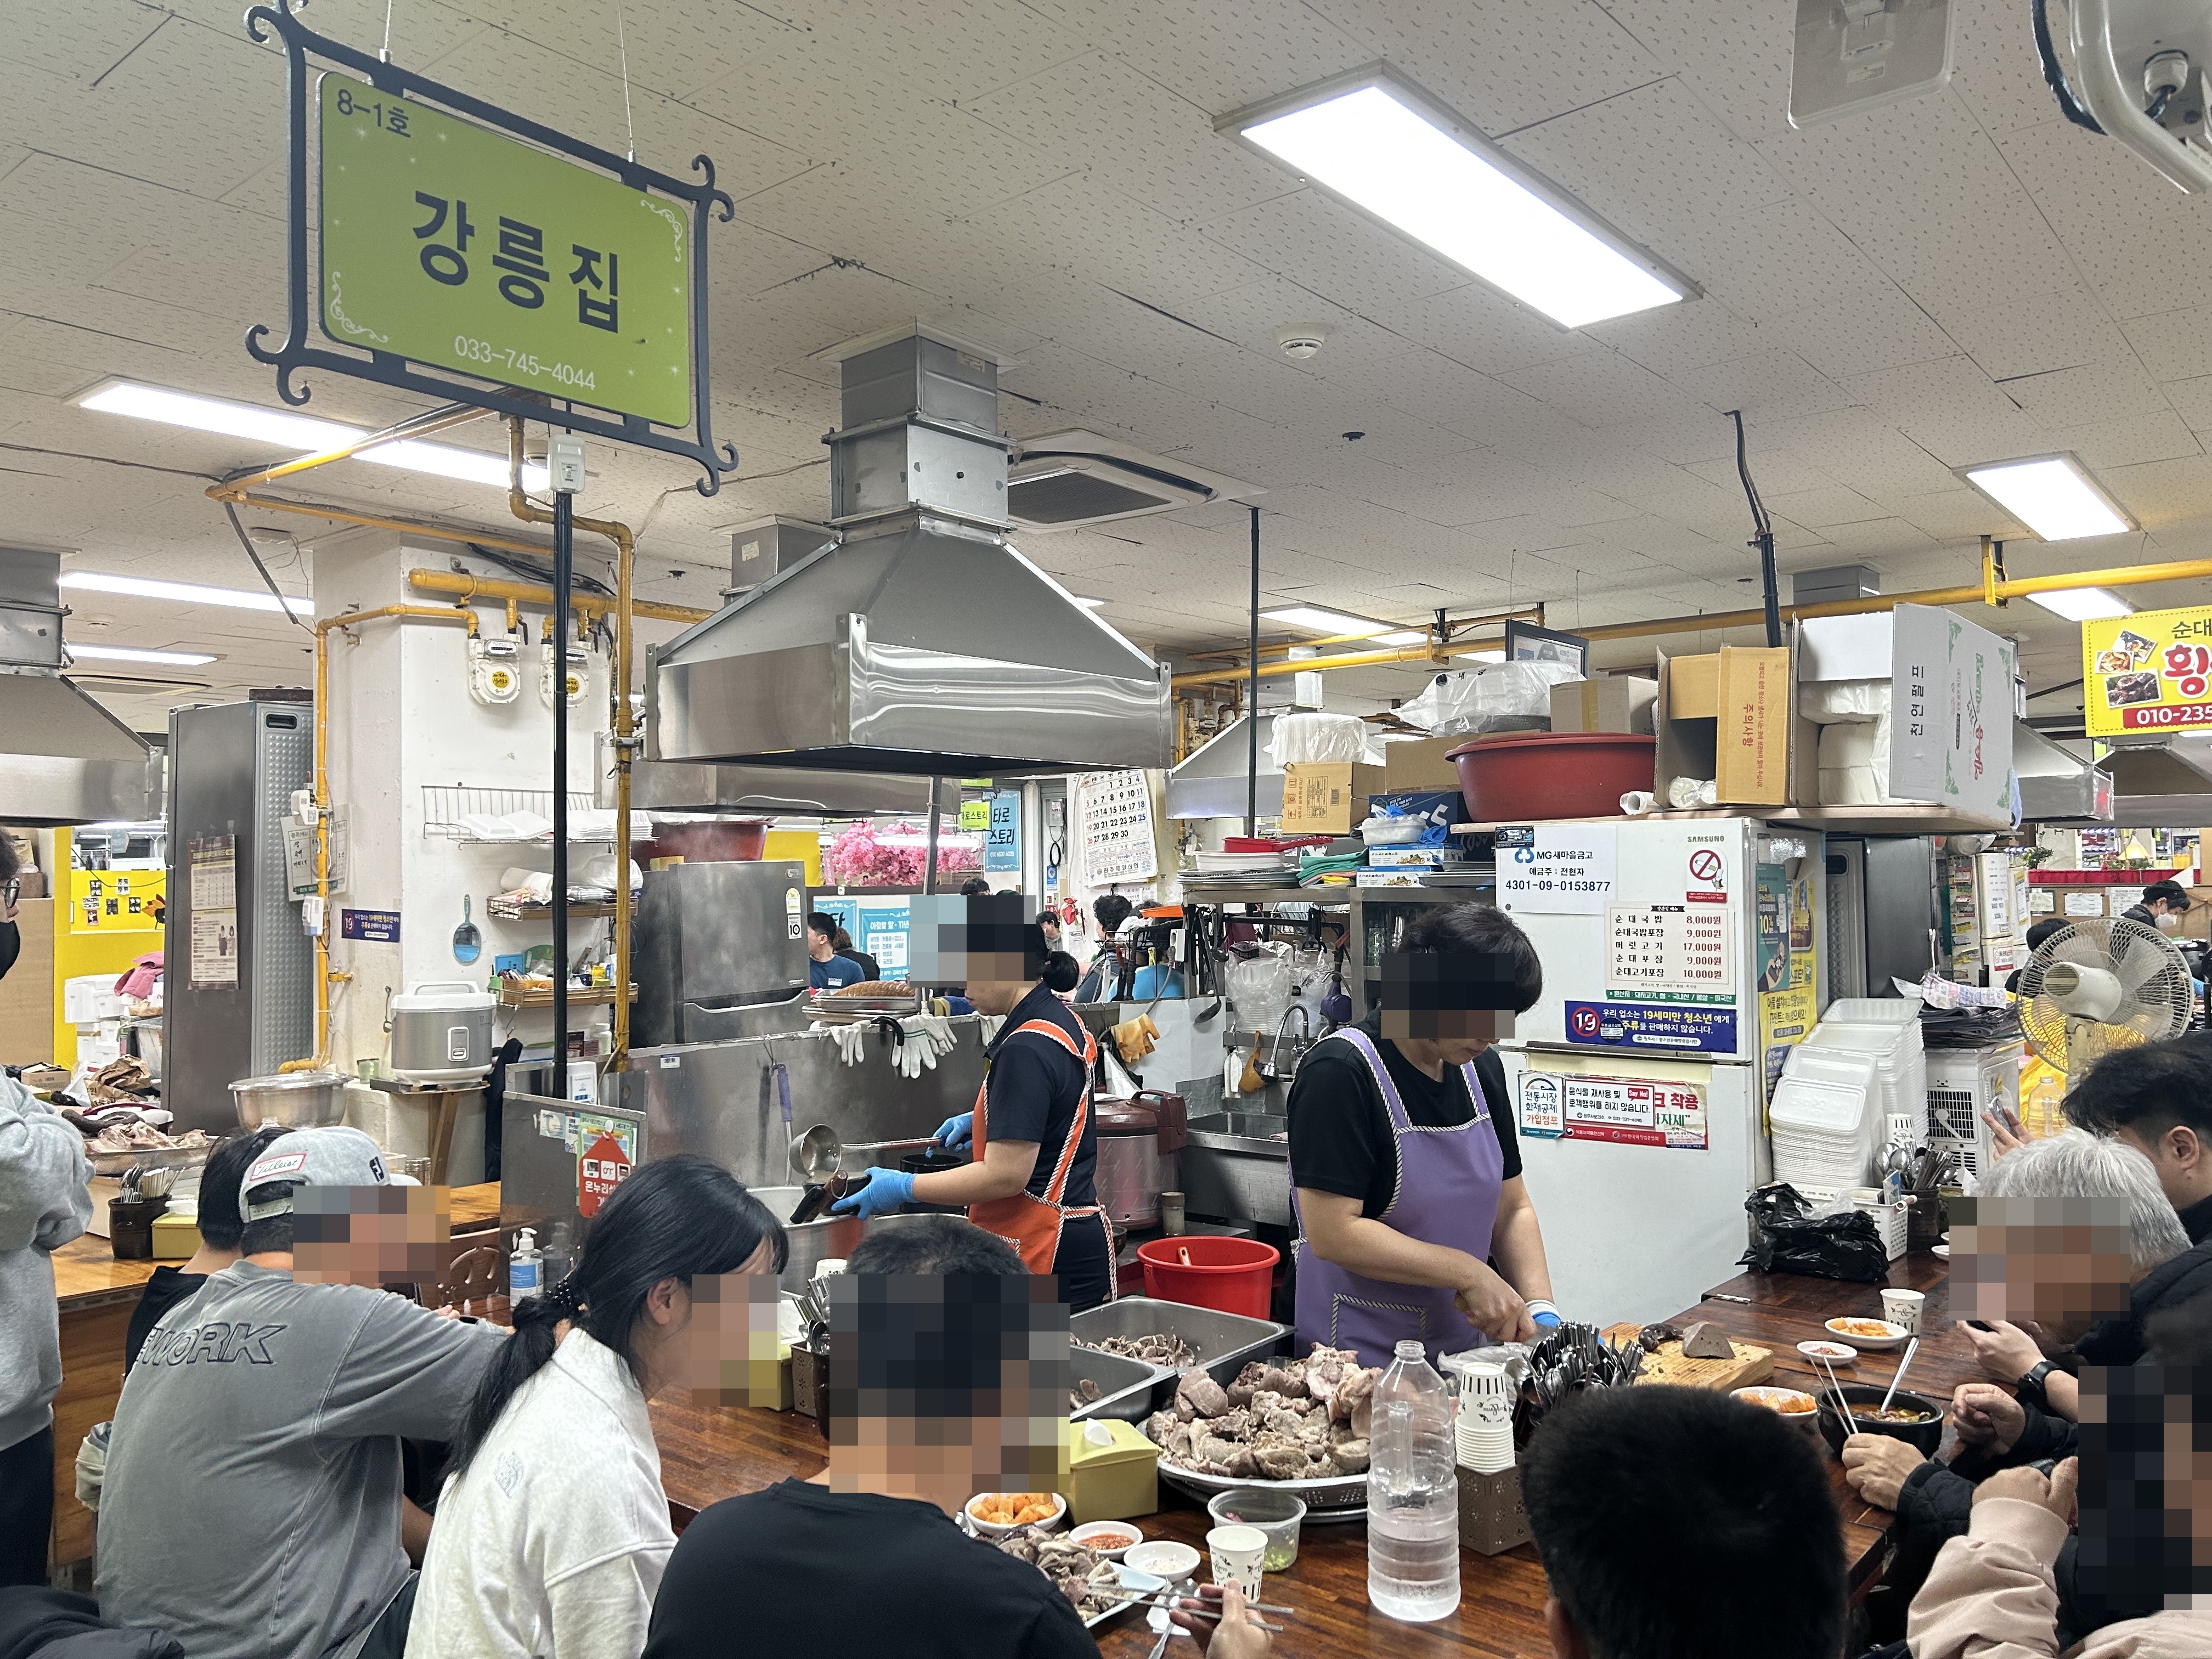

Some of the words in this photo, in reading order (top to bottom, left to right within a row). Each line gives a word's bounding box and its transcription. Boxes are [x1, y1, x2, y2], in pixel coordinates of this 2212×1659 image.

[337, 88, 411, 138] 8-1호
[412, 190, 618, 334] 강릉집
[454, 335, 596, 390] 033-745-4044
[2165, 644, 2212, 695] 횡
[1910, 665, 1924, 736] 천연펄프
[1742, 703, 1754, 747] 주의사항
[993, 807, 1010, 824] 타로
[989, 828, 1015, 845] 스토리
[1529, 867, 1553, 876] 예금주
[1560, 867, 1585, 877] 전현자
[1505, 880, 1611, 891] 4301-09-0153877
[1615, 915, 1663, 924] 순대국밥
[1686, 916, 1722, 925] 8,000원
[790, 924, 800, 935] 10
[1615, 928, 1664, 937] 순대국밥포장
[1686, 929, 1722, 938] 9,000원
[1684, 943, 1722, 952] 17,000원
[1616, 953, 1663, 963] 순대포장
[1687, 957, 1722, 966] 9,000원
[1615, 967, 1664, 977] 순대고기포장
[1684, 970, 1722, 979] 10,000원
[1576, 1012, 1596, 1031] 19
[1602, 1009, 1616, 1017] 우리
[1618, 1009, 1640, 1019] 업소는
[1643, 1011, 1681, 1020] 19세미만
[1684, 1013, 1712, 1025] 청소년
[1714, 1015, 1729, 1024] 에게
[1622, 1020, 1647, 1030] 주류를
[1649, 1022, 1678, 1032] 판매하지
[1680, 1024, 1713, 1034] 않습니다.
[1525, 1091, 1557, 1103] 전통시장
[1591, 1088, 1611, 1098] 재사용
[1569, 1098, 1602, 1109] 호객행위를
[1605, 1102, 1618, 1110] 하지
[1621, 1103, 1650, 1114] 않습니다.
[1670, 1092, 1699, 1110] 착용
[1525, 1103, 1558, 1114] 화재공제
[1527, 1114, 1558, 1125] 가입점포
[1656, 1113, 1691, 1126] 자제”
[256, 1158, 300, 1176] Titleist
